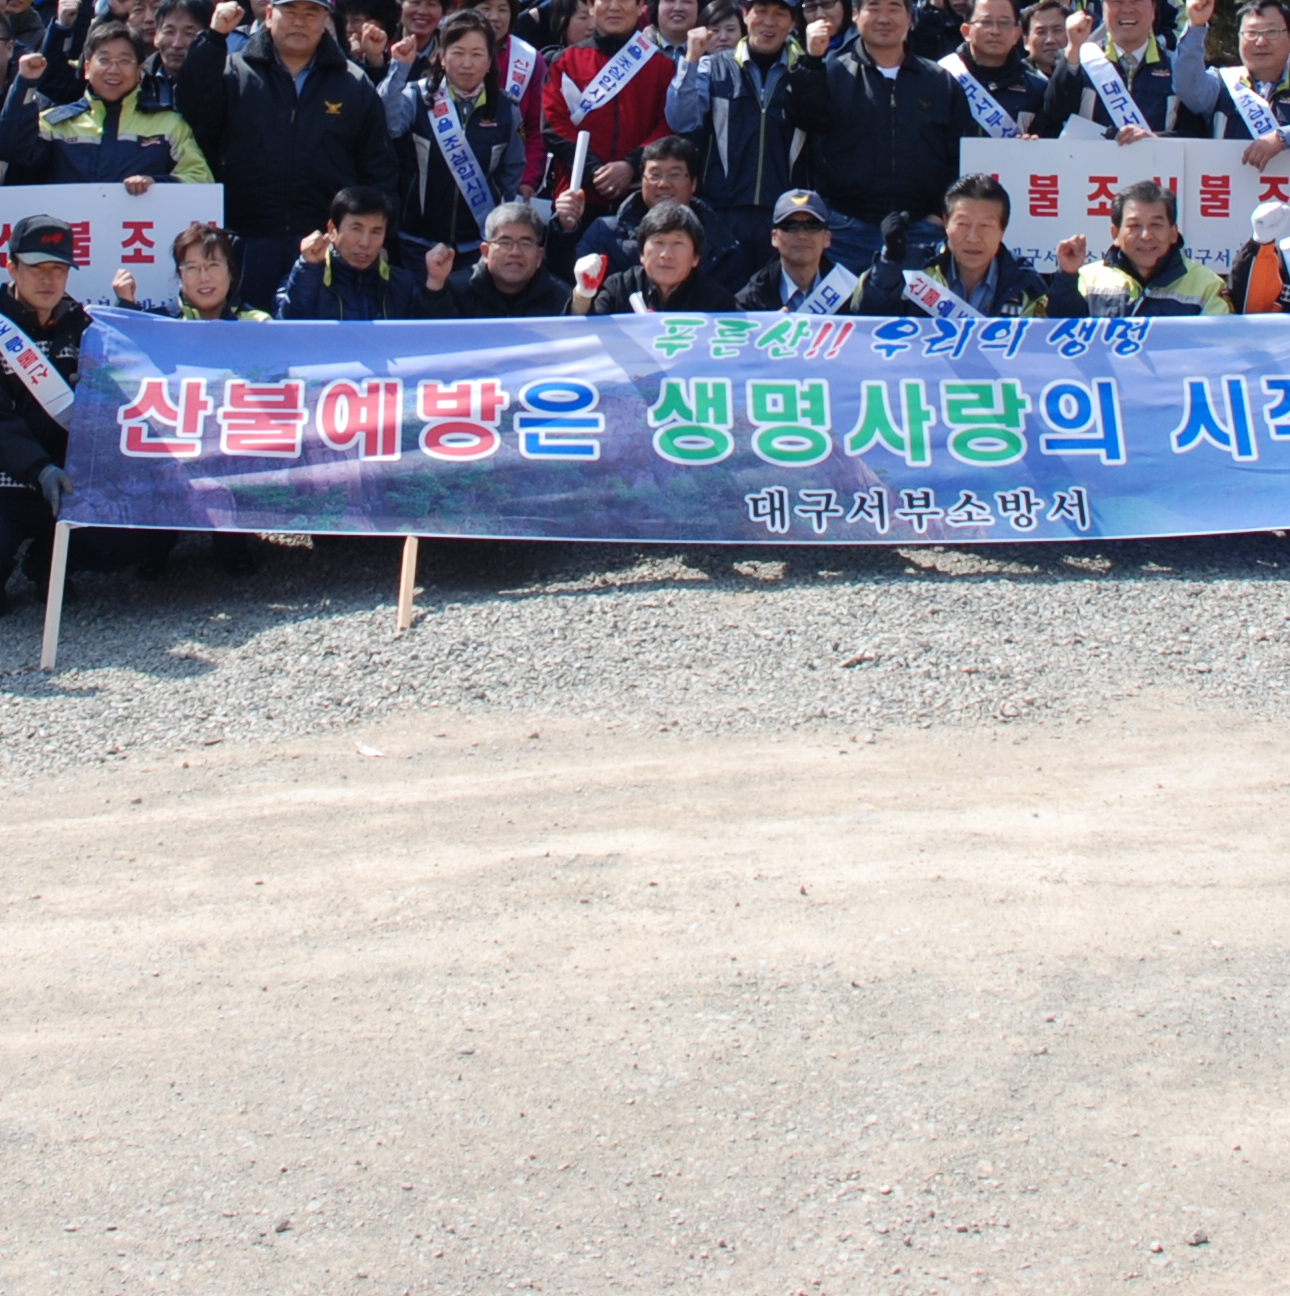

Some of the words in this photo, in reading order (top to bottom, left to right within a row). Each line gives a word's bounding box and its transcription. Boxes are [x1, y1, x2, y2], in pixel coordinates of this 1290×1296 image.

[652, 316, 856, 360] 푸른산!!
[871, 316, 1031, 359] 우리의
[1049, 316, 1154, 358] 생명
[118, 377, 604, 462] 산불예방은
[647, 375, 1127, 467] 생명사랑의
[746, 485, 1091, 533] 대구서부소방서
